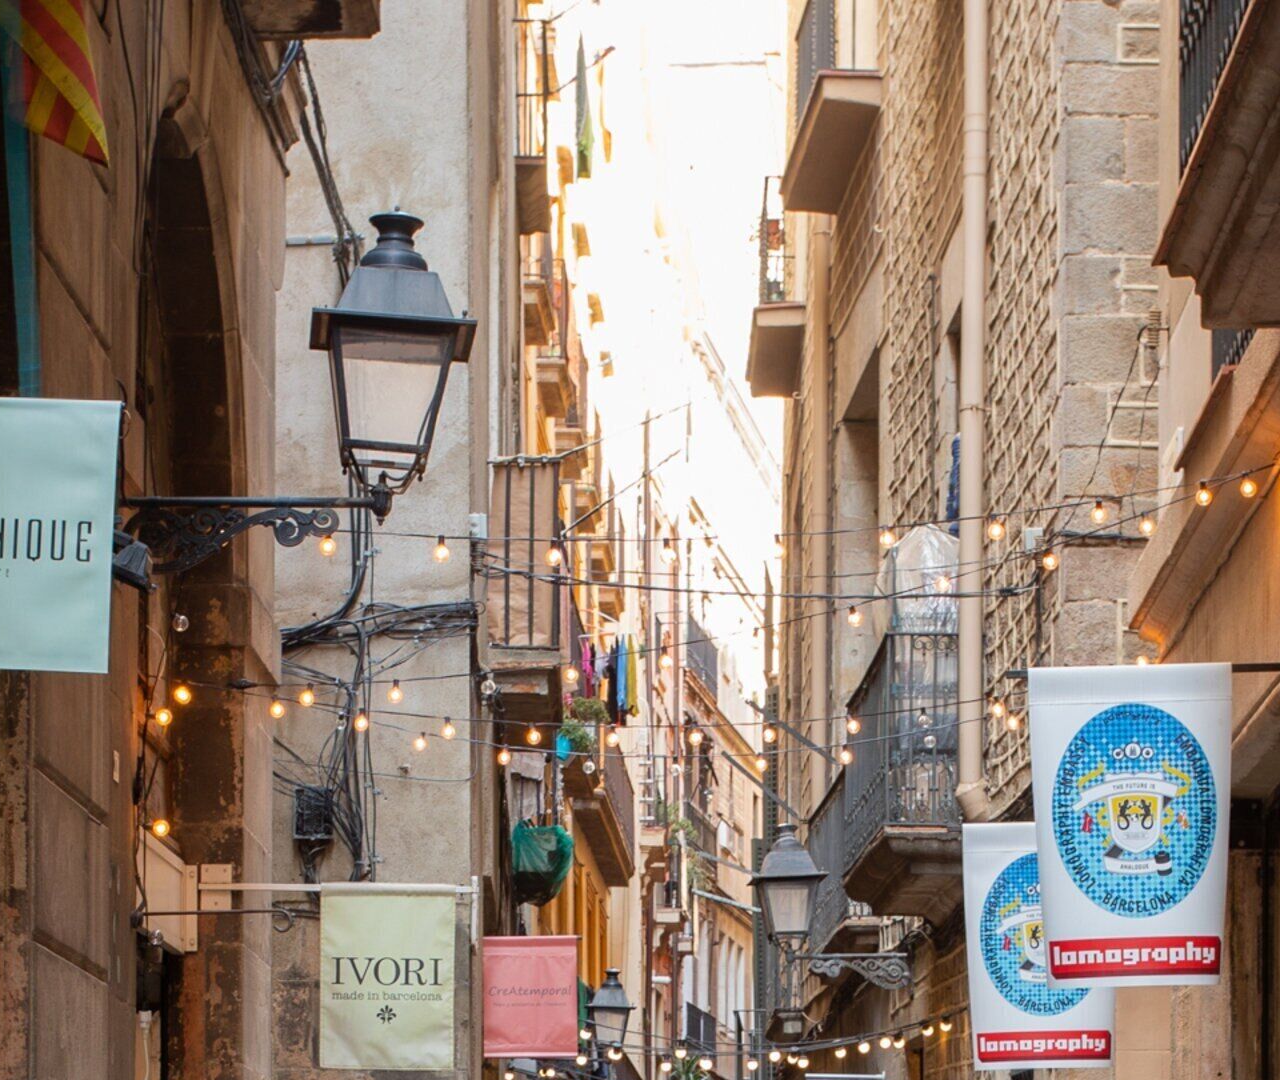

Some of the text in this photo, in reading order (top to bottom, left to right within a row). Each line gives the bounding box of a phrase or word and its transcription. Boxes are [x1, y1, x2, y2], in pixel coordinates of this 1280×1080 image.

[1174, 732, 1210, 796] EMBAJADA
[1058, 735, 1096, 890] LOMOGRAPHY EMBASSY
[1102, 890, 1176, 913] BARCELONA
[1054, 942, 1216, 966] lomography
[331, 956, 443, 986] IVORI
[332, 991, 443, 1001] made in barcelona
[488, 985, 572, 997] CreAtemporal
[1019, 996, 1074, 1013] BARCELONA
[979, 1034, 1106, 1053] lomography
